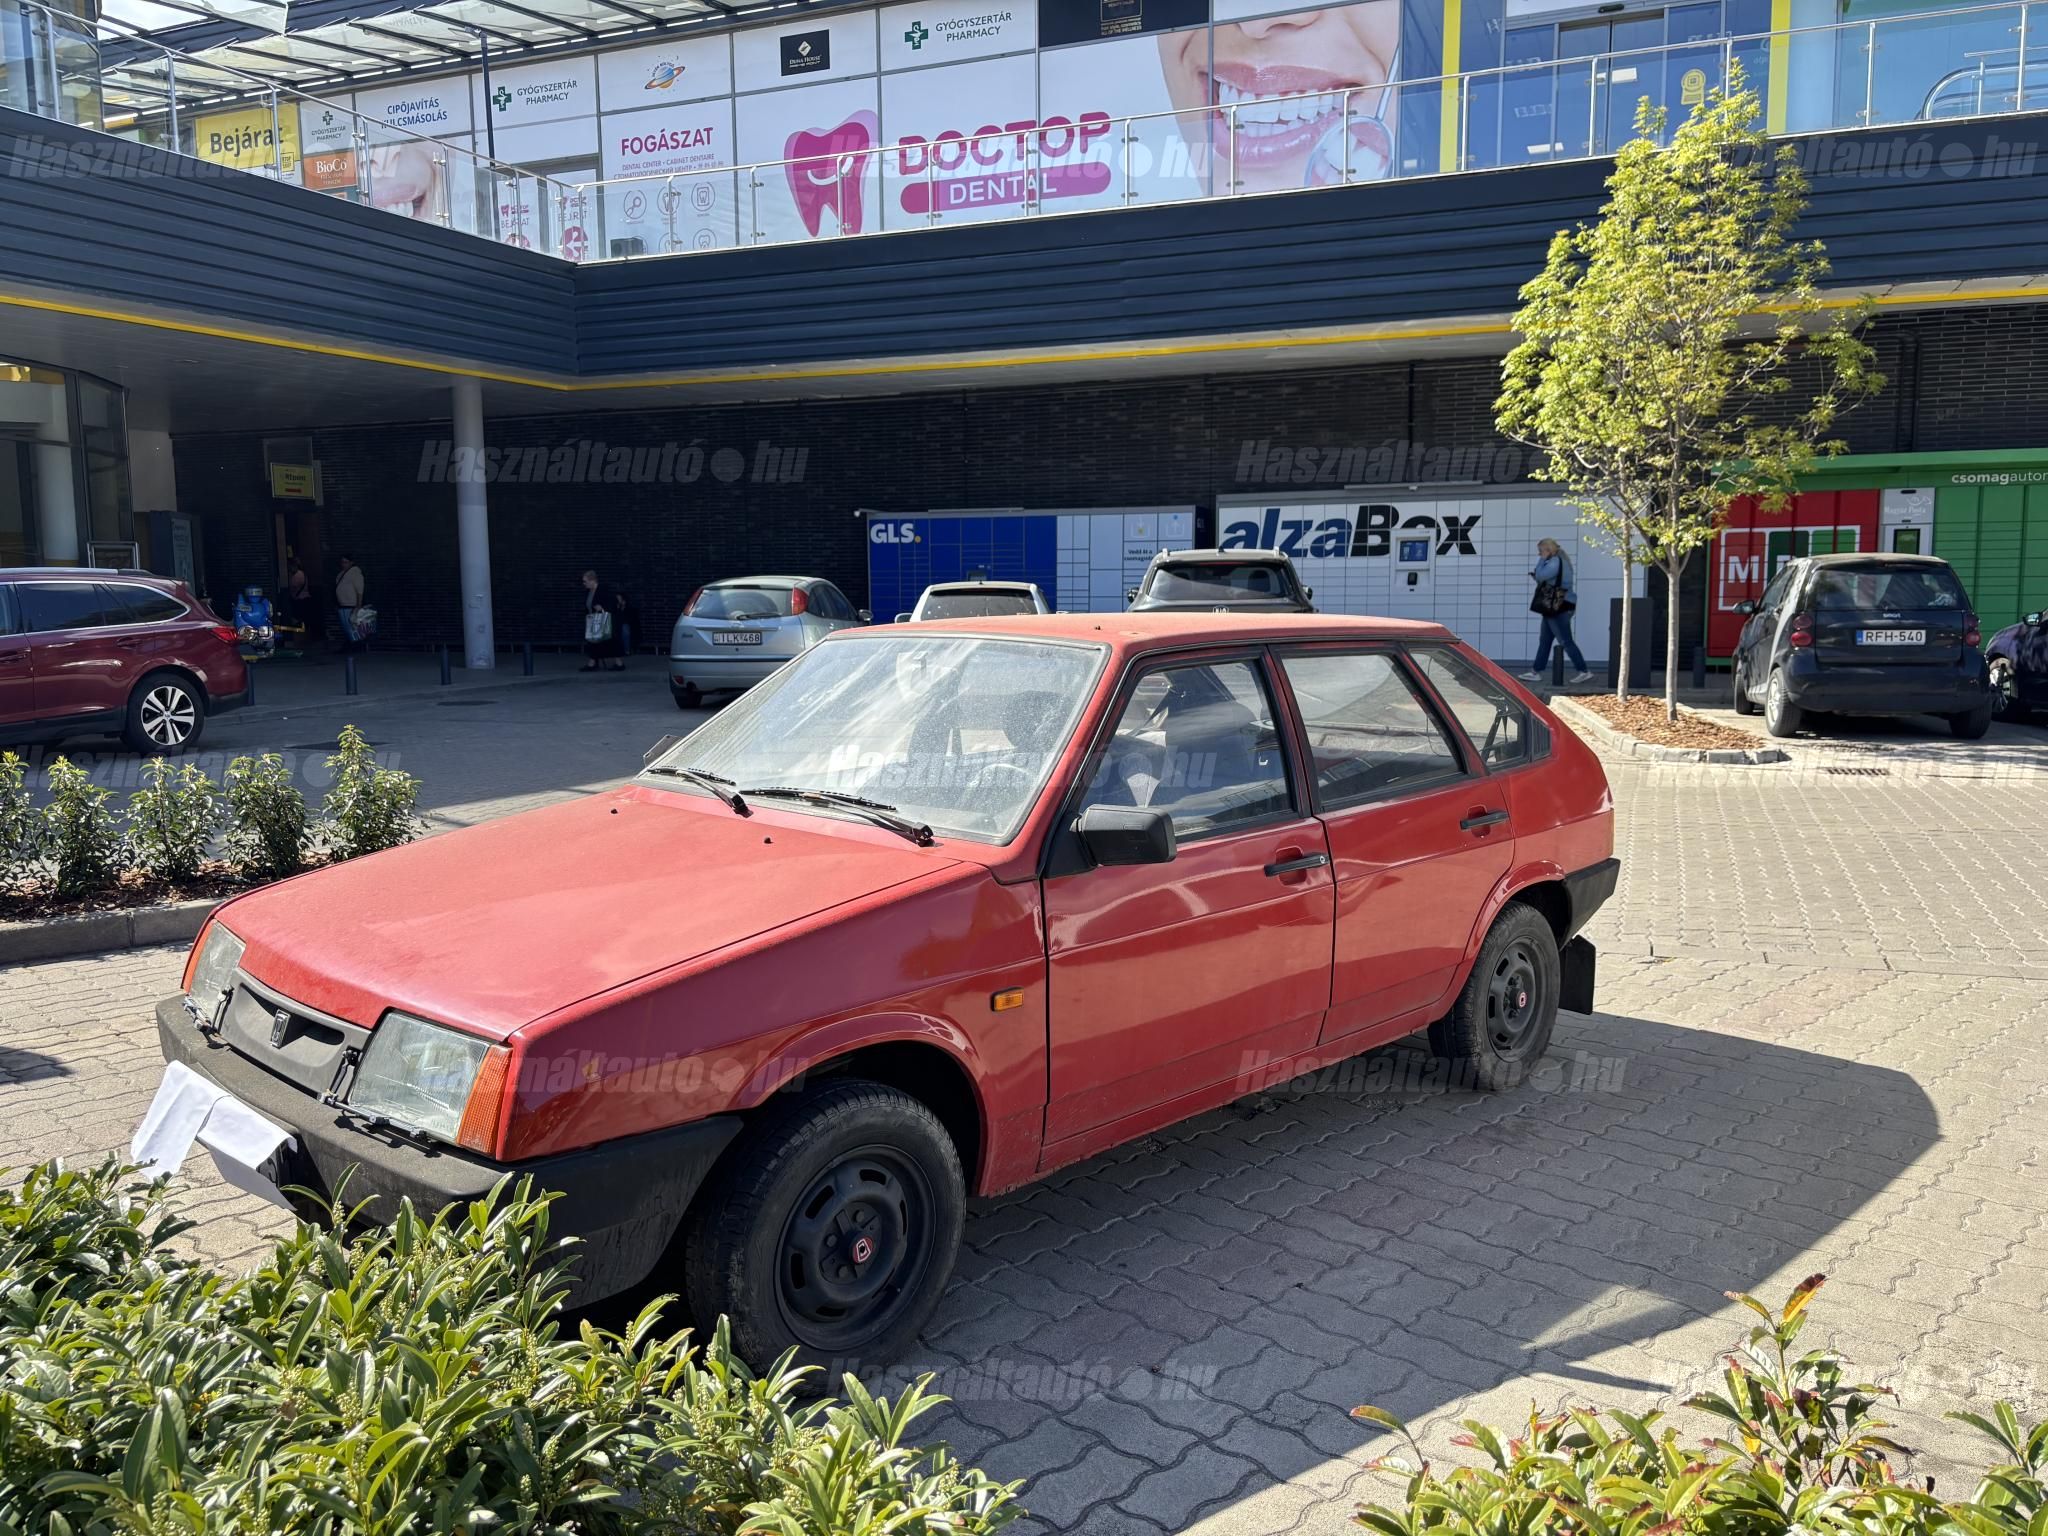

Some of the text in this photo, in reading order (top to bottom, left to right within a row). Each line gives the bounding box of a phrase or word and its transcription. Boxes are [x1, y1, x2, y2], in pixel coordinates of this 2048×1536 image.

[936, 12, 1012, 32] GYÓGYSZERTÁR
[946, 26, 1001, 42] PHARMACY
[516, 79, 578, 97] GYÓGYSZERTÁR
[387, 98, 440, 116] CIPŐJAVÍTÁS
[526, 92, 569, 106] PHARMACY
[210, 126, 284, 158] Bejárat
[316, 132, 343, 142] PHARMACY
[621, 127, 714, 156] FOGÁSZAT
[898, 111, 1111, 176] DOCTOP
[622, 163, 641, 171] DENTAL
[642, 160, 661, 169] CENTER
[666, 156, 688, 166] CABINET
[690, 153, 715, 162] DENTAIRE
[949, 172, 1057, 205] DENTAL
[1865, 631, 1924, 643] RFH-540
